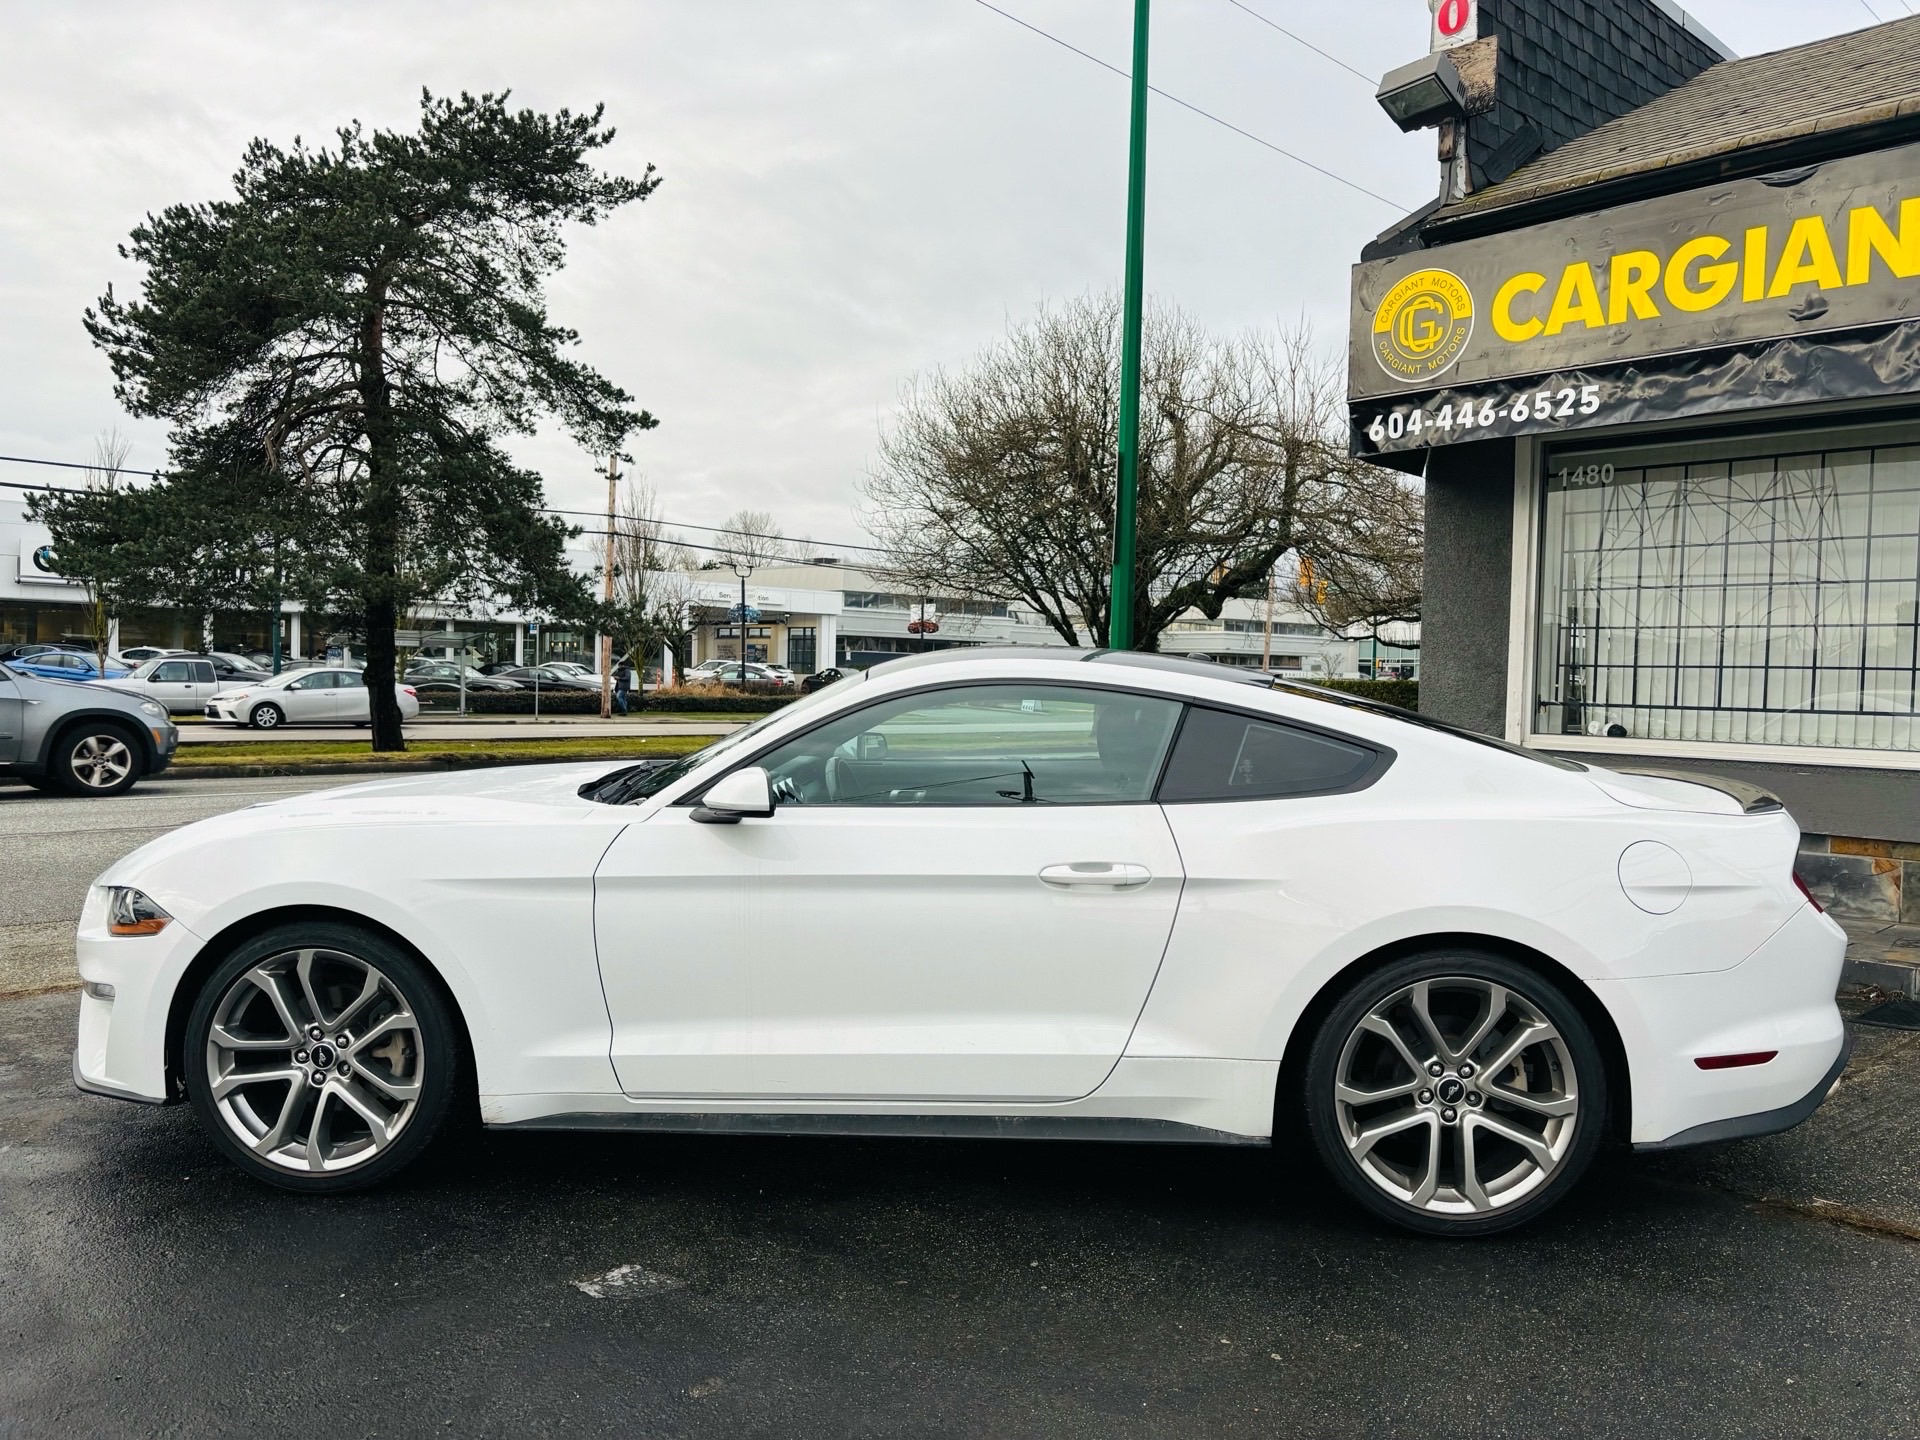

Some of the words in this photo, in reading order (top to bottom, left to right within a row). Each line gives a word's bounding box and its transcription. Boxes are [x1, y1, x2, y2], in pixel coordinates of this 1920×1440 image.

[1380, 278, 1425, 323] CARGIANT
[1431, 277, 1466, 311] MOTORS
[1379, 341, 1422, 374] CARGIANT
[1427, 326, 1466, 371] MOTORS
[1368, 385, 1601, 442] 604-446-6525
[1558, 463, 1615, 487] 1480
